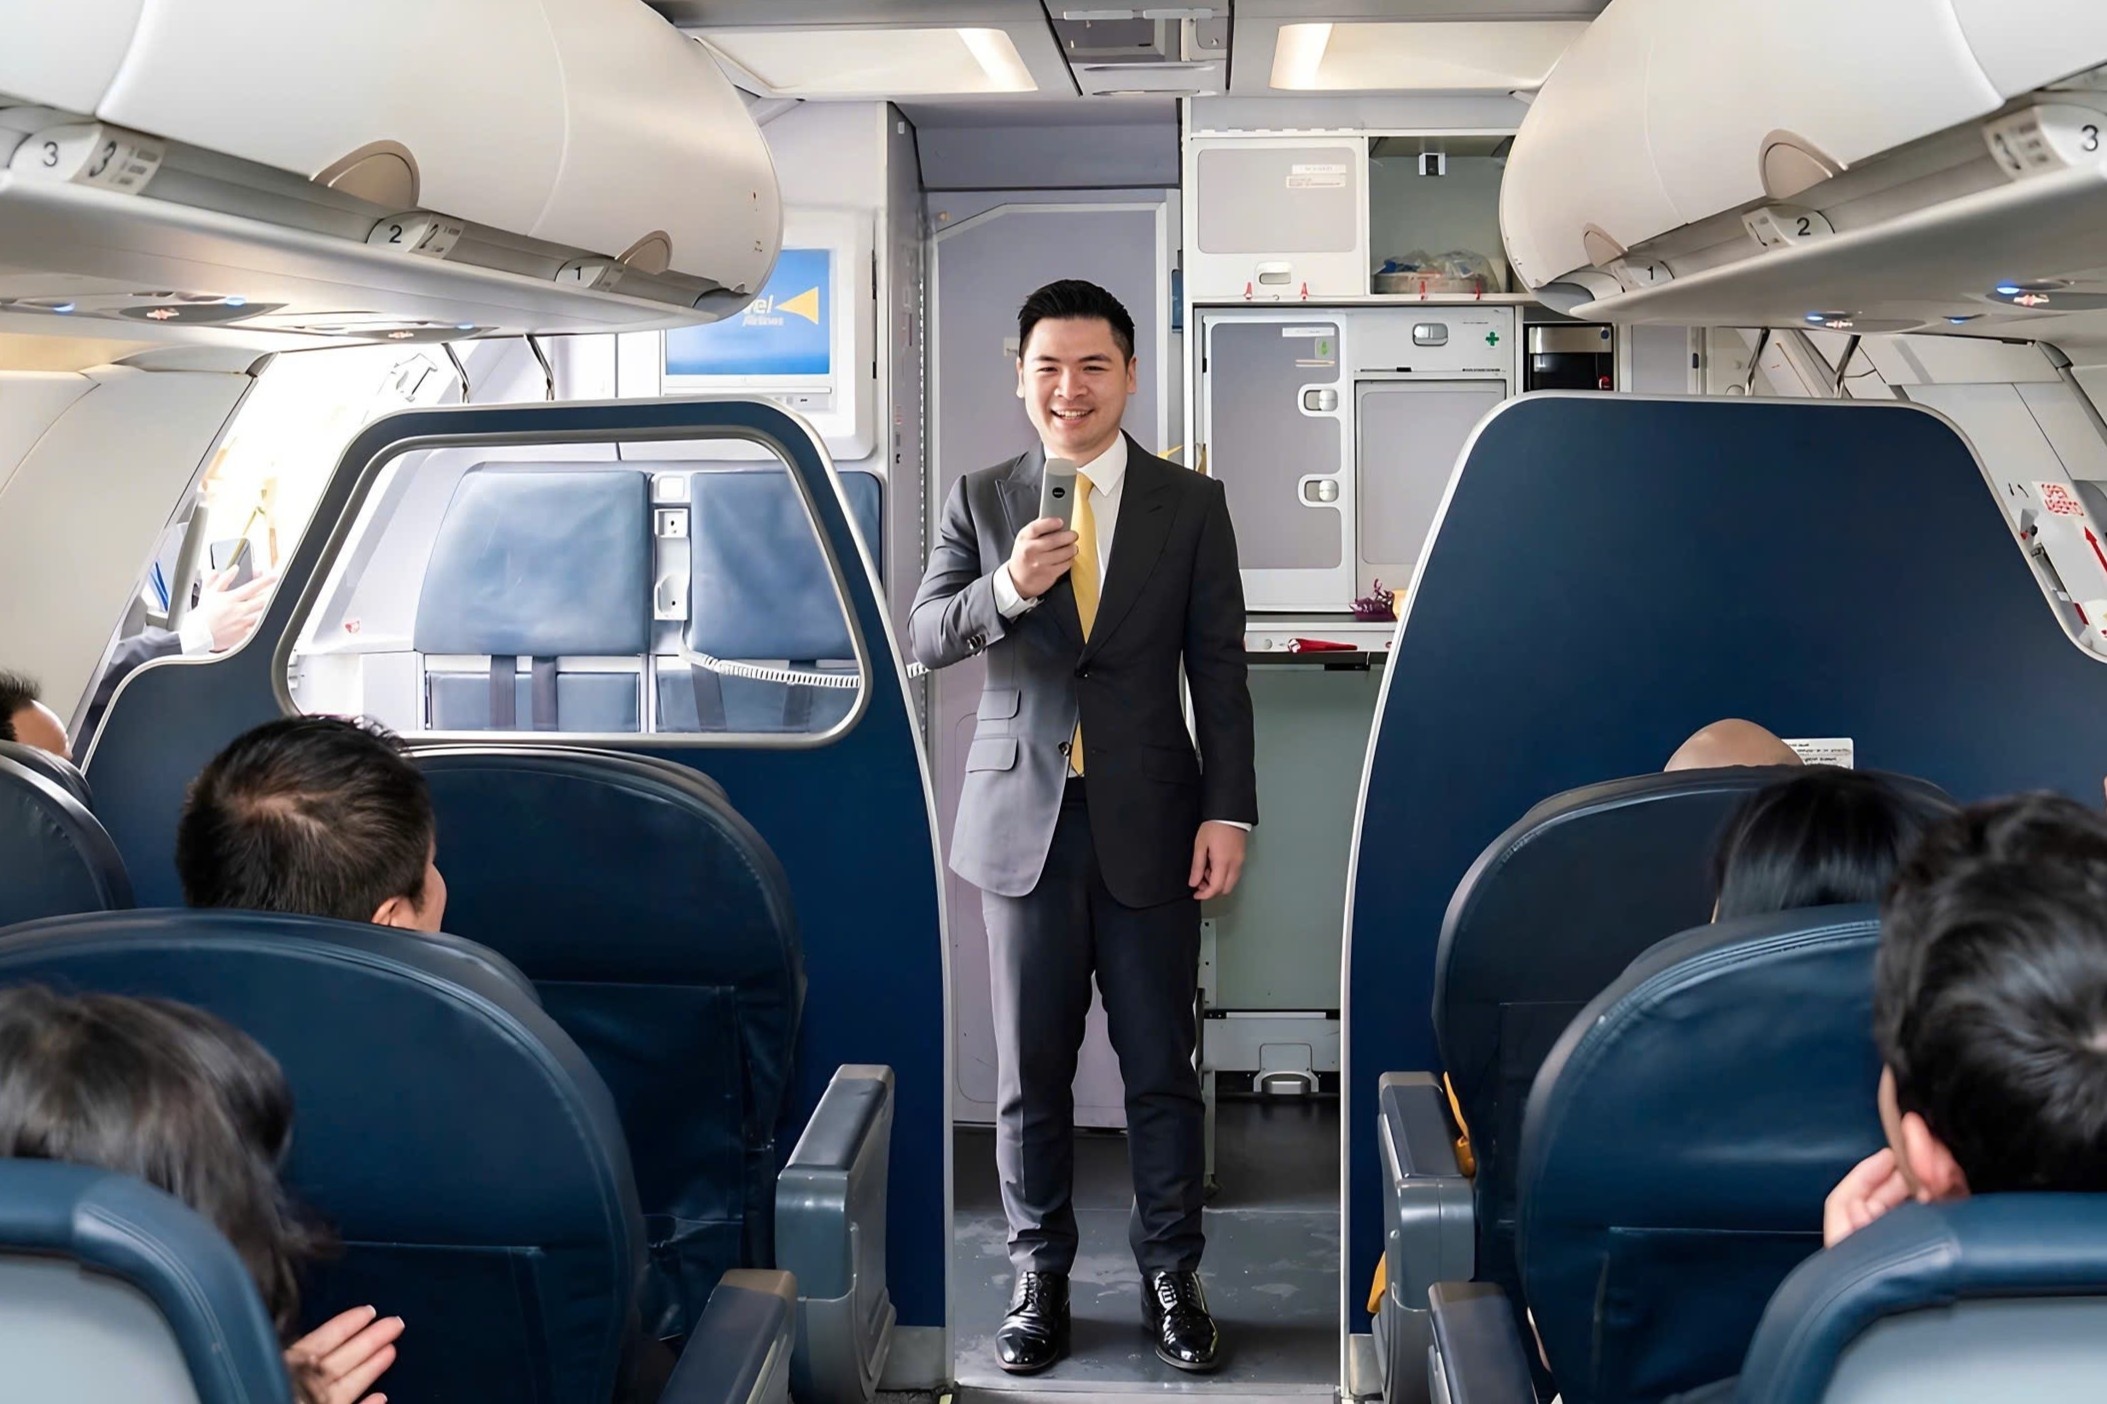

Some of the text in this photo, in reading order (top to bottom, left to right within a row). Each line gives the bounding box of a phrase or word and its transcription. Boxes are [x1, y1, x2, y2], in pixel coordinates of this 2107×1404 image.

[2082, 124, 2098, 152] 3
[43, 141, 59, 167] 3
[389, 224, 403, 243] 2
[1797, 217, 1811, 236] 2
[575, 266, 582, 280] 1
[1648, 266, 1654, 281] 1
